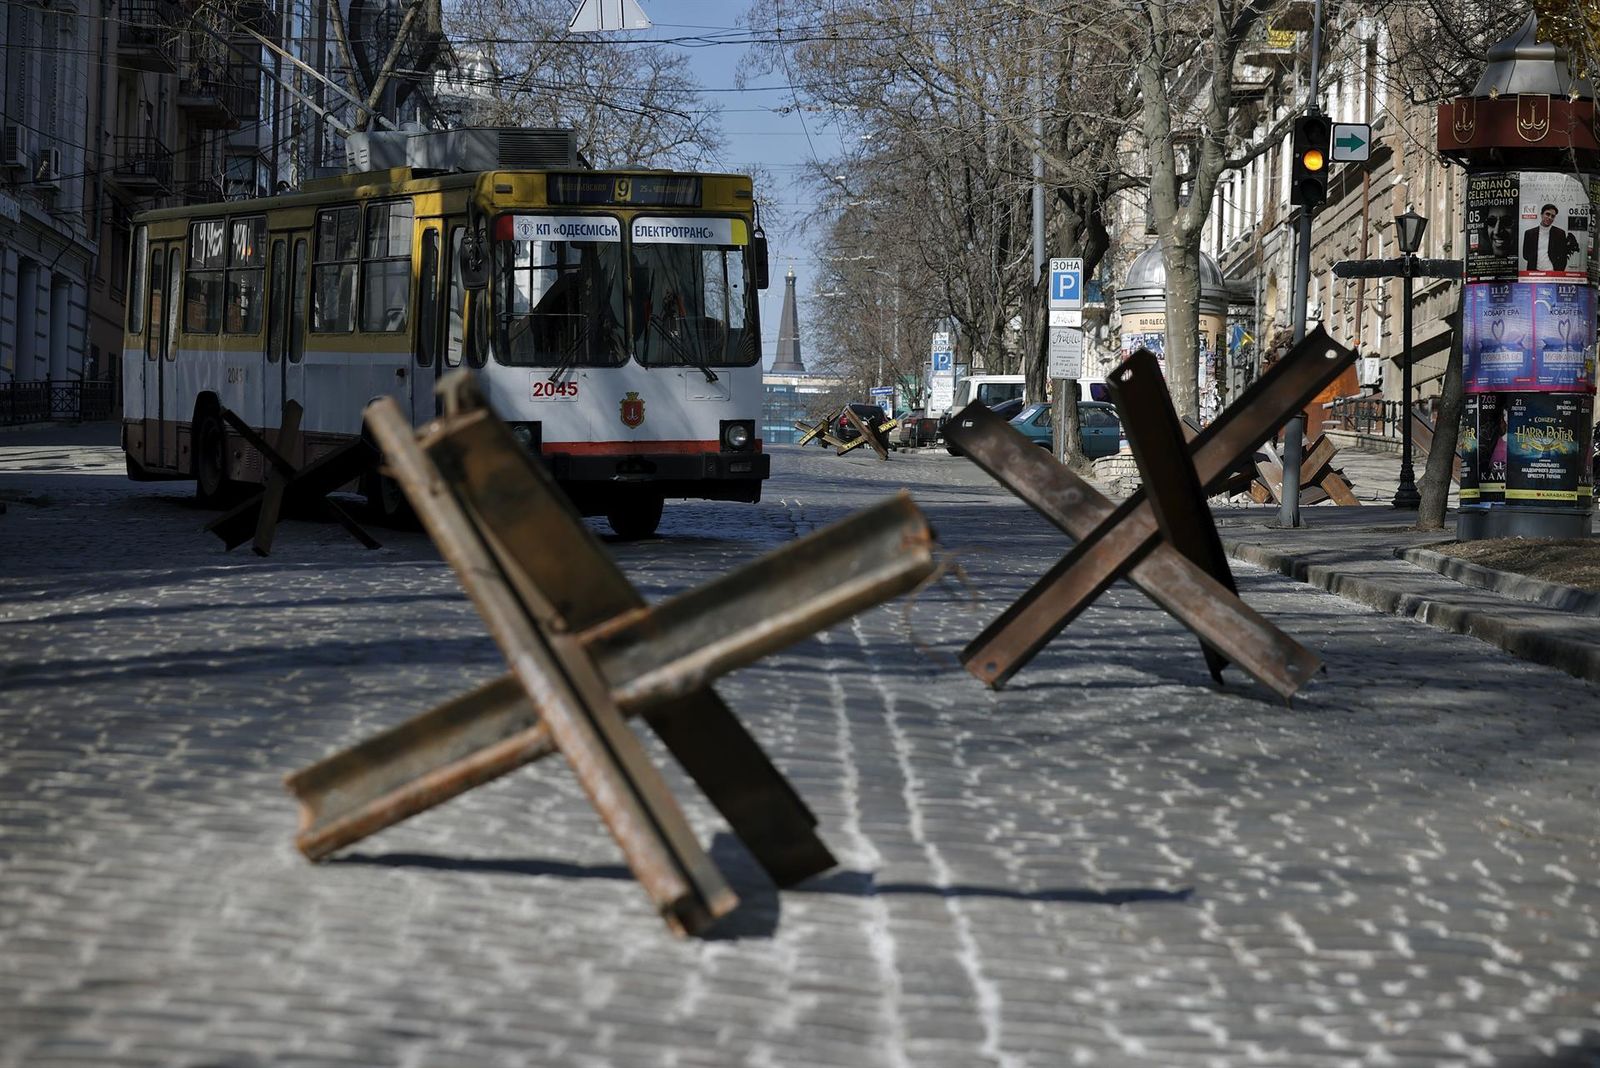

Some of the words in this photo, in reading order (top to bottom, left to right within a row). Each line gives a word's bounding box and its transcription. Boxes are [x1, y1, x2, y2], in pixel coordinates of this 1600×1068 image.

[617, 179, 629, 198] 9
[1472, 179, 1511, 190] ADRIANO
[1468, 188, 1519, 200] CELENTANO
[1469, 211, 1480, 223] 05
[536, 223, 550, 235] КП
[553, 223, 618, 236] «ОДЕСМІСЬК
[635, 225, 714, 238] ЕЛЕКТРОТРАНС»
[1053, 261, 1080, 270] ЗОНА
[533, 382, 578, 397] 2045
